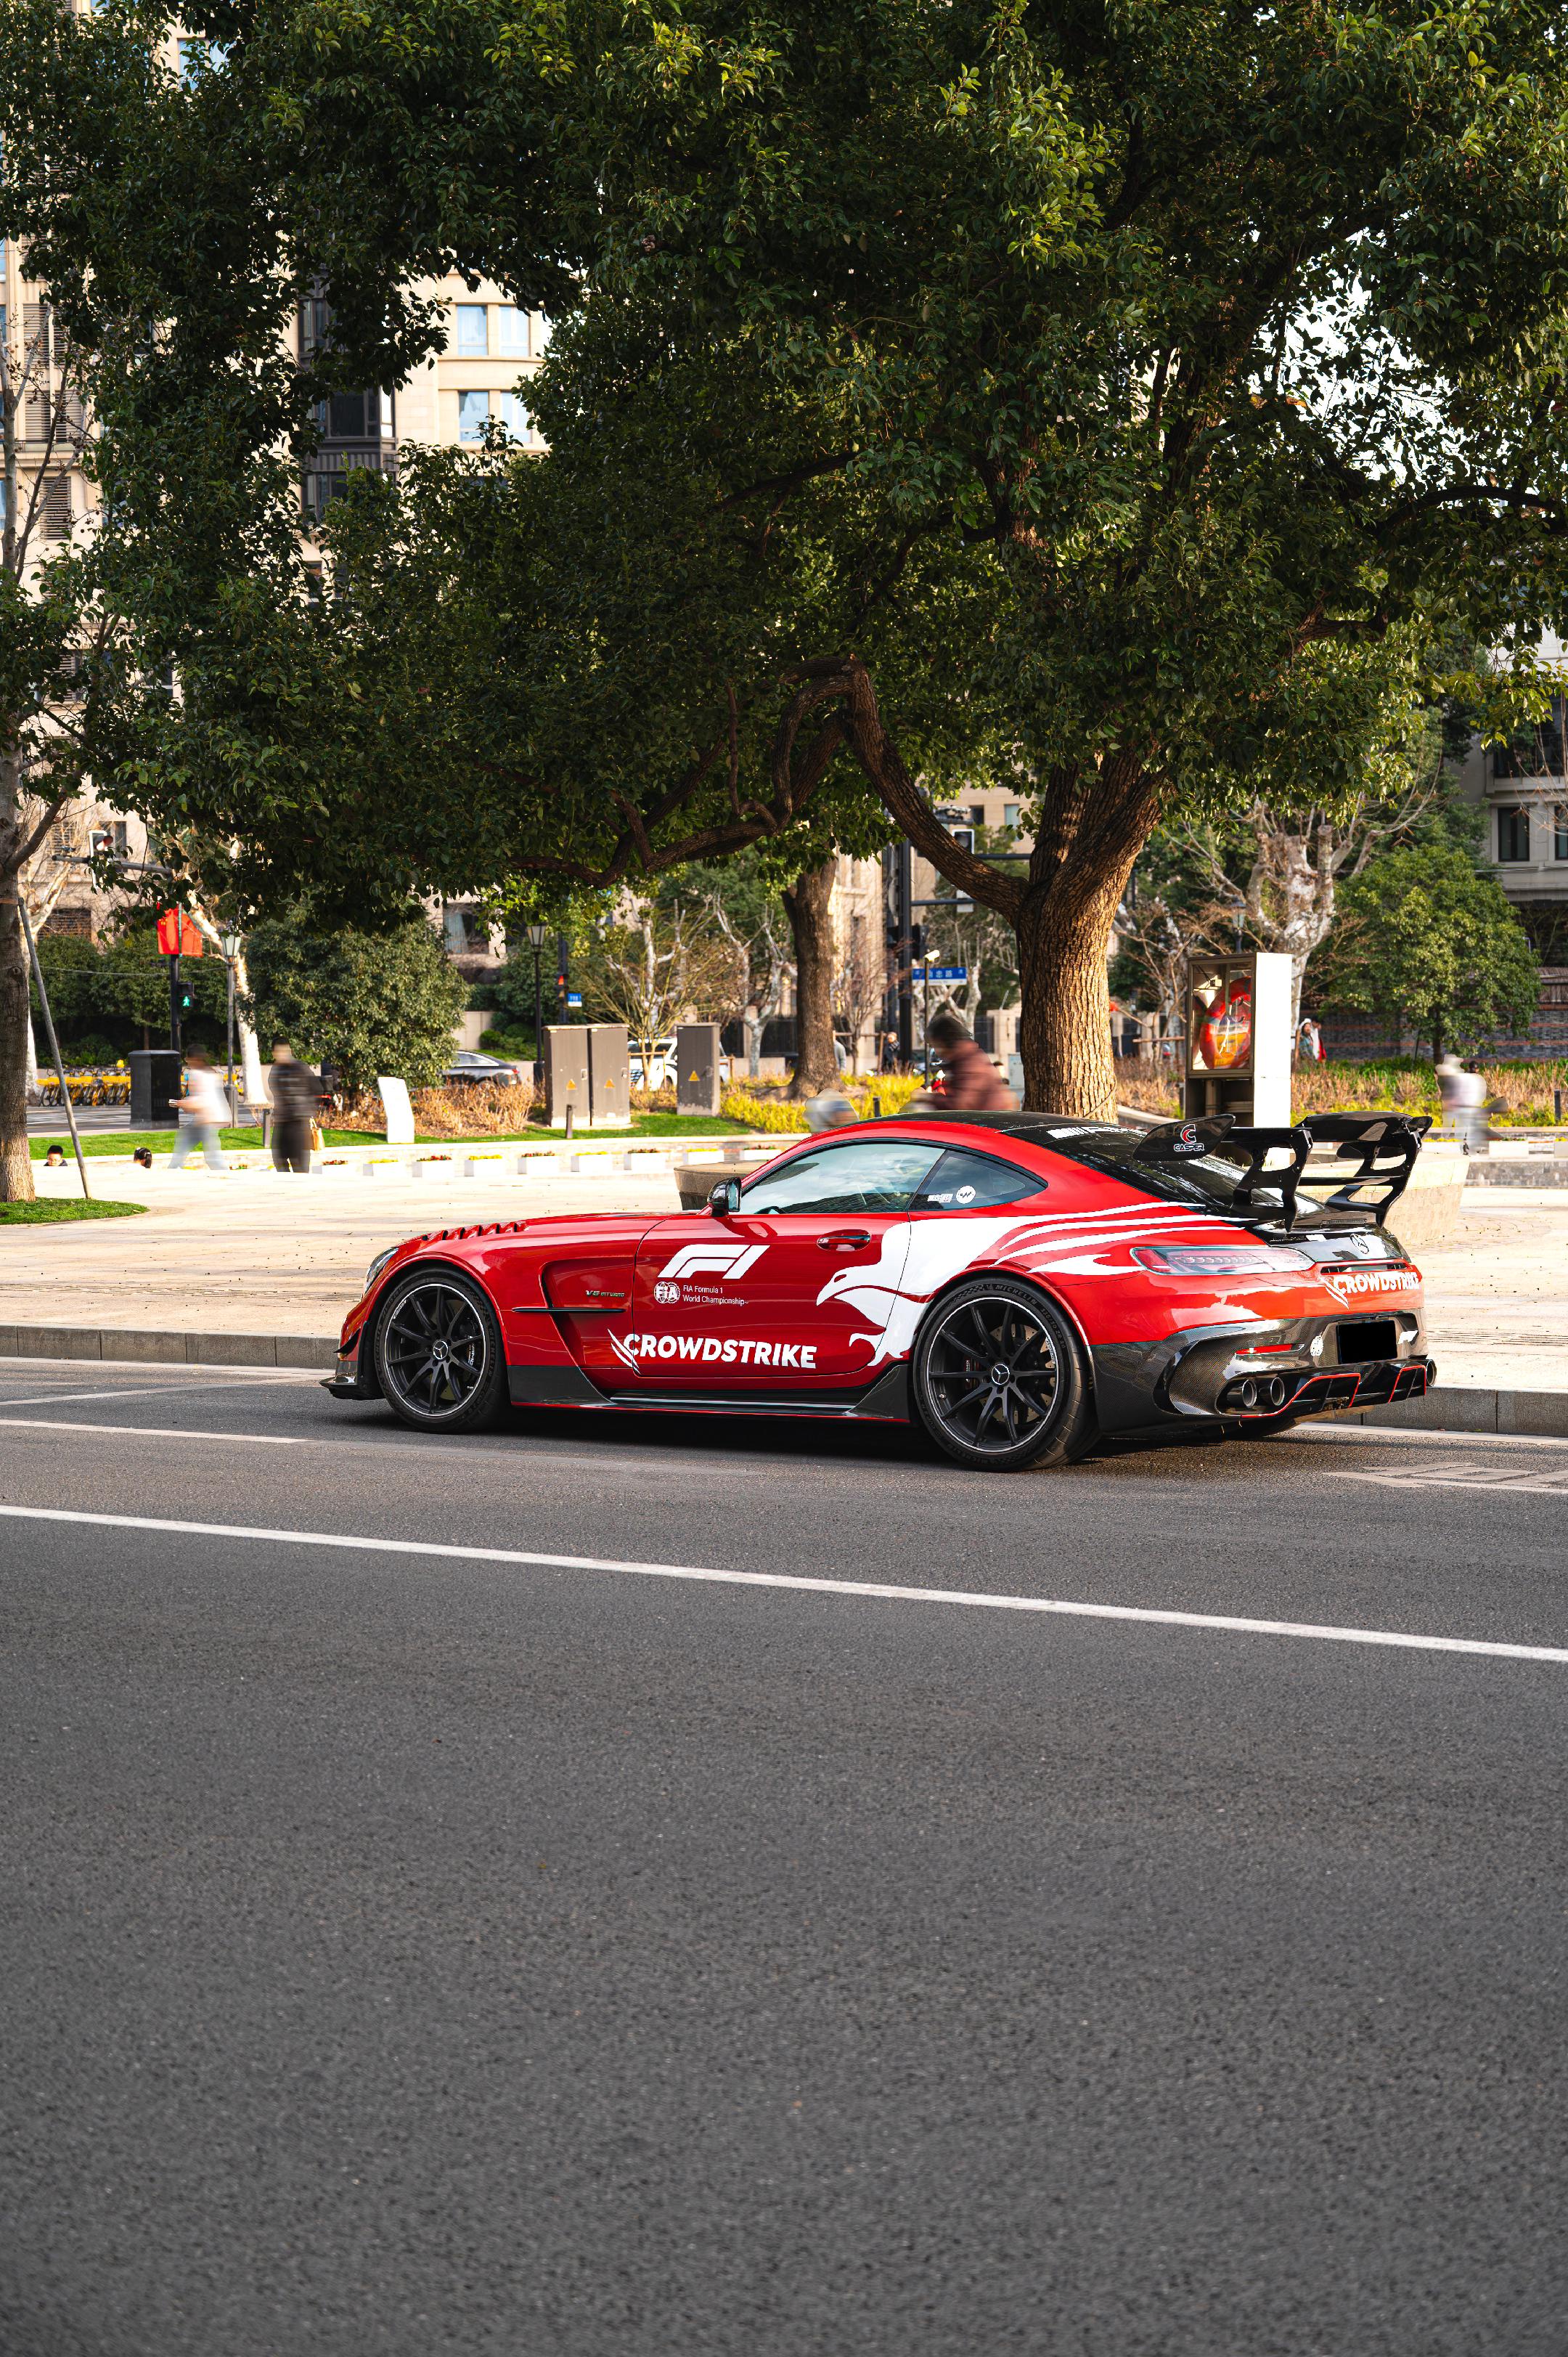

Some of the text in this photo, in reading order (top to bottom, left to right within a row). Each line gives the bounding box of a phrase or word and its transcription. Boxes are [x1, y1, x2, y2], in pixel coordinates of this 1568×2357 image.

[1174, 1143, 1204, 1152] CASPER
[657, 1244, 770, 1279] F1
[656, 1285, 679, 1299] FIA
[1333, 1271, 1420, 1294] CROWDSTRIKE
[701, 1295, 745, 1306] Championship
[995, 1285, 1037, 1305] MICHELIN
[623, 1333, 817, 1369] CROWDSTRIKE
